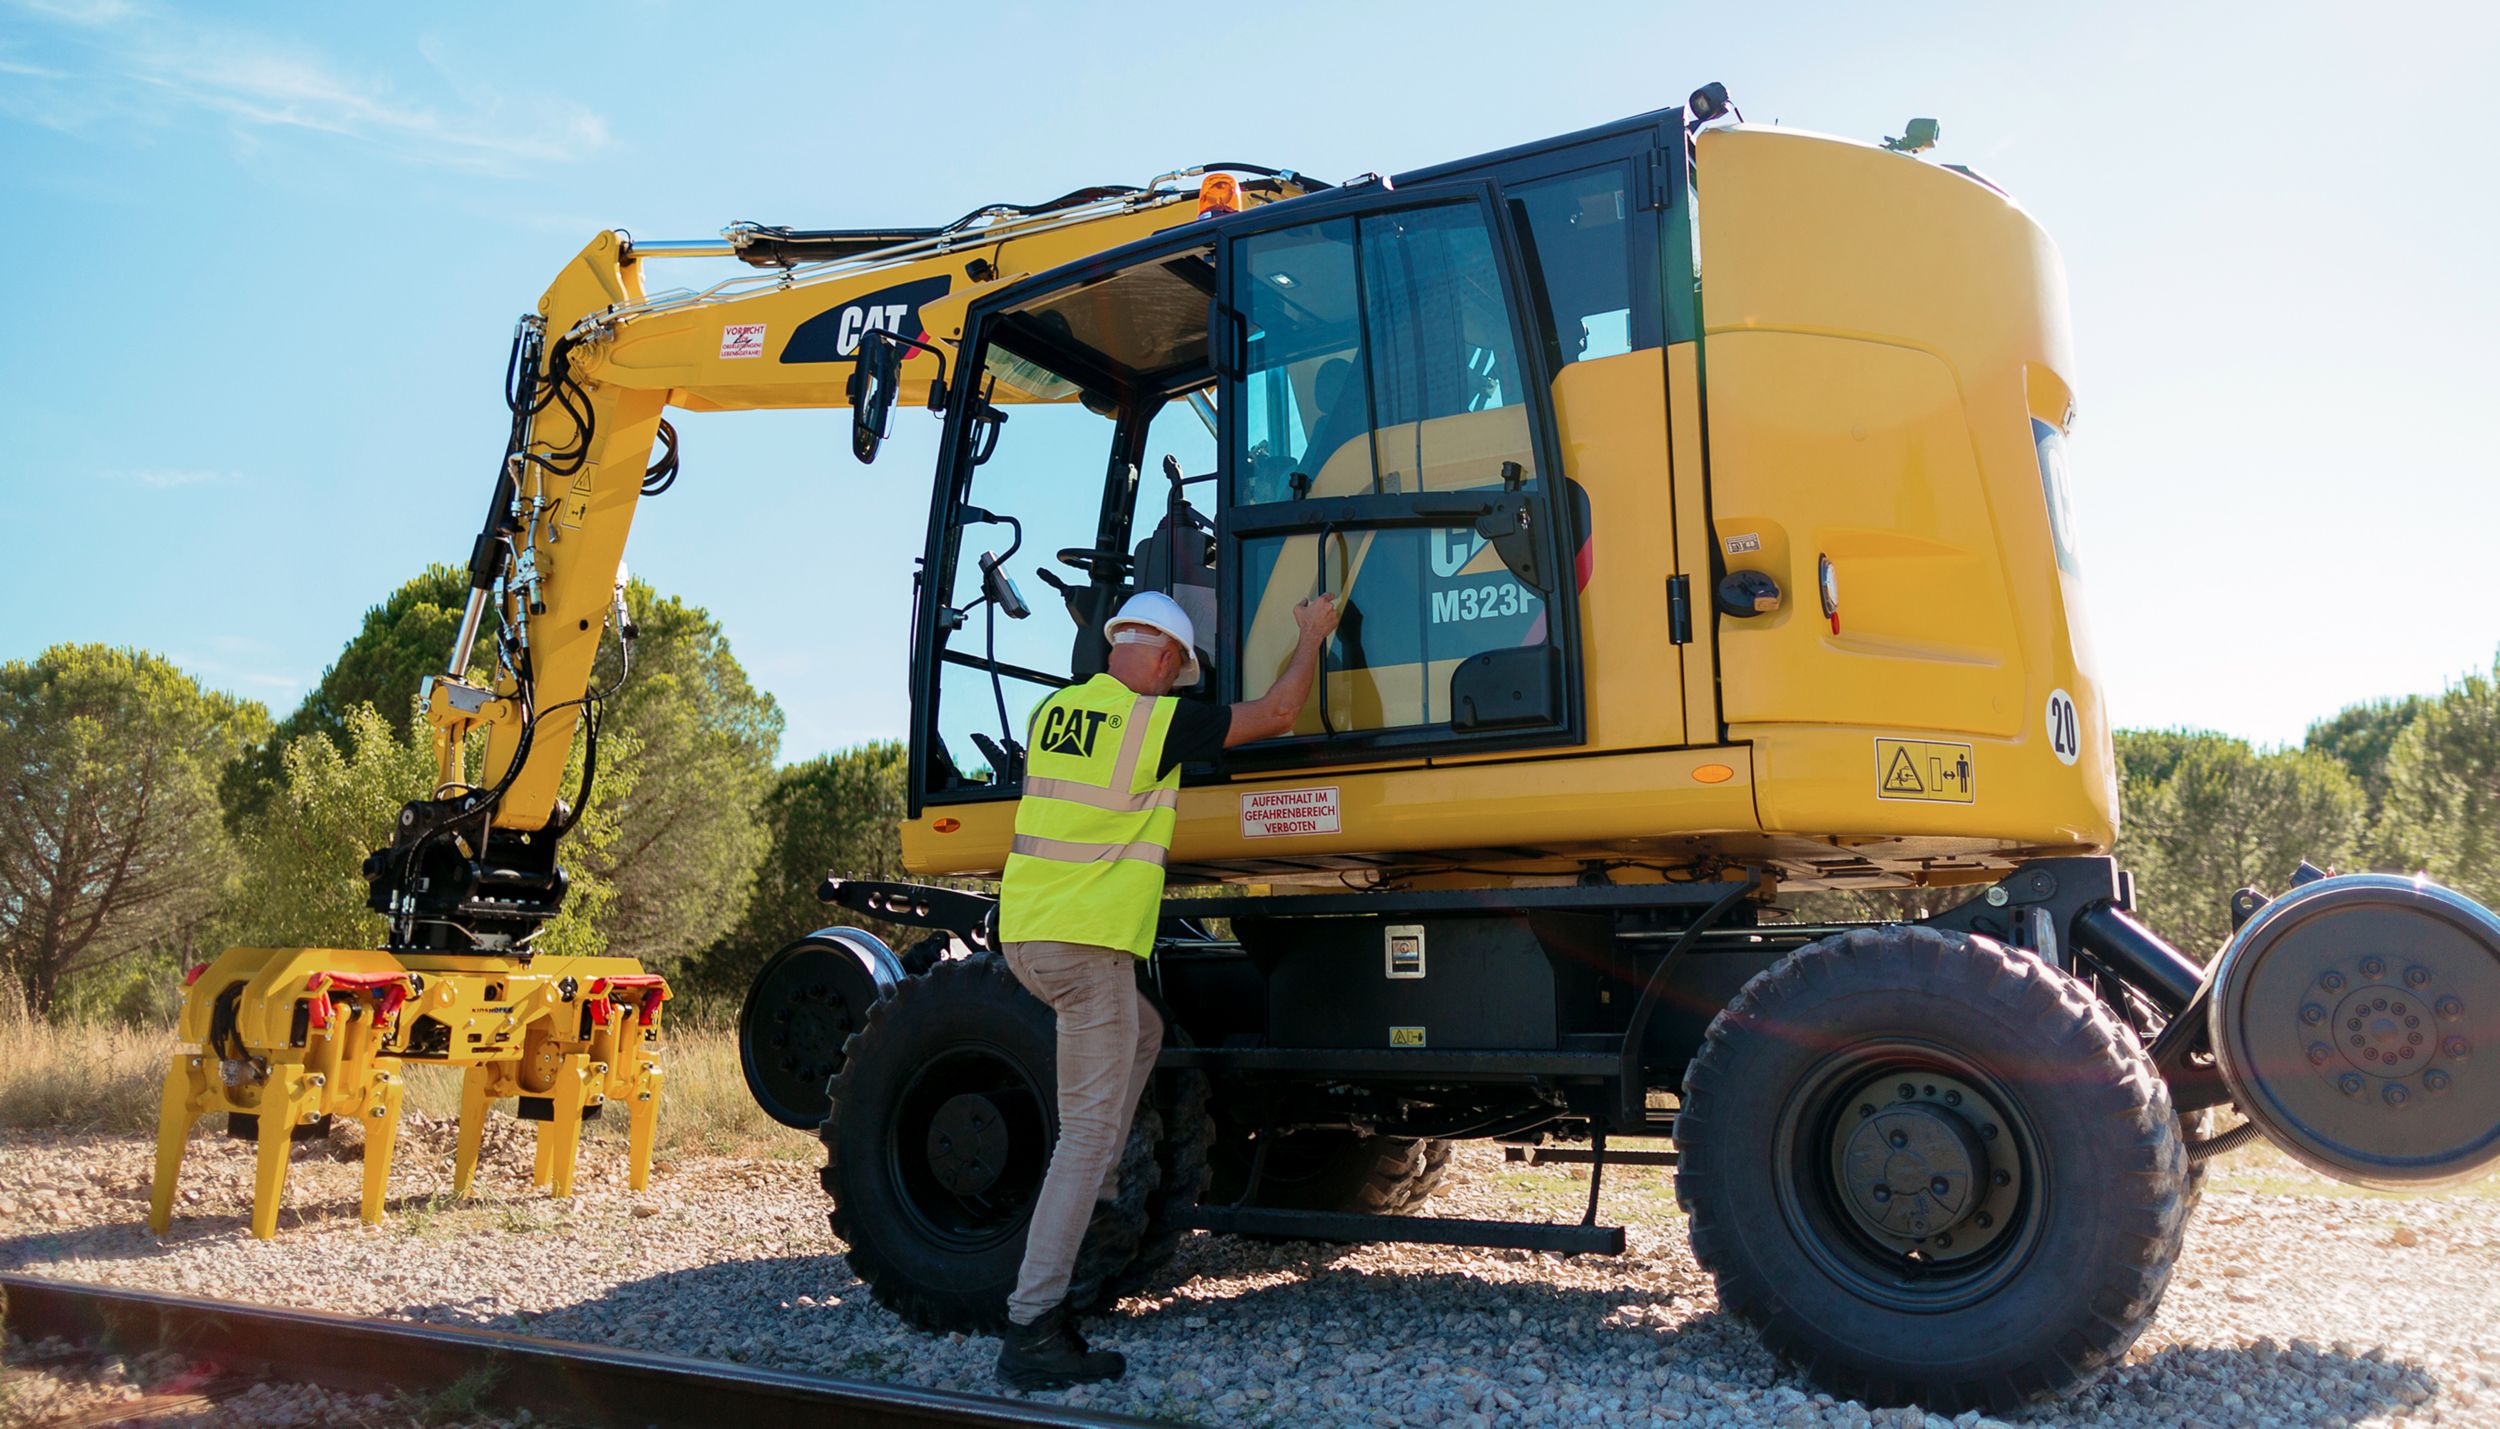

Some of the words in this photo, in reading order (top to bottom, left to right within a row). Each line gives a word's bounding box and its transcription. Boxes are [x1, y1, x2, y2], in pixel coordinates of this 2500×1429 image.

[837, 304, 908, 356] CAT
[2052, 697, 2076, 757] 20
[1251, 793, 1312, 807] AUFENTHALT
[1315, 792, 1328, 803] IM
[1244, 805, 1335, 821] GEFAHRENBEREICH
[1264, 820, 1316, 833] VERBOTEN
